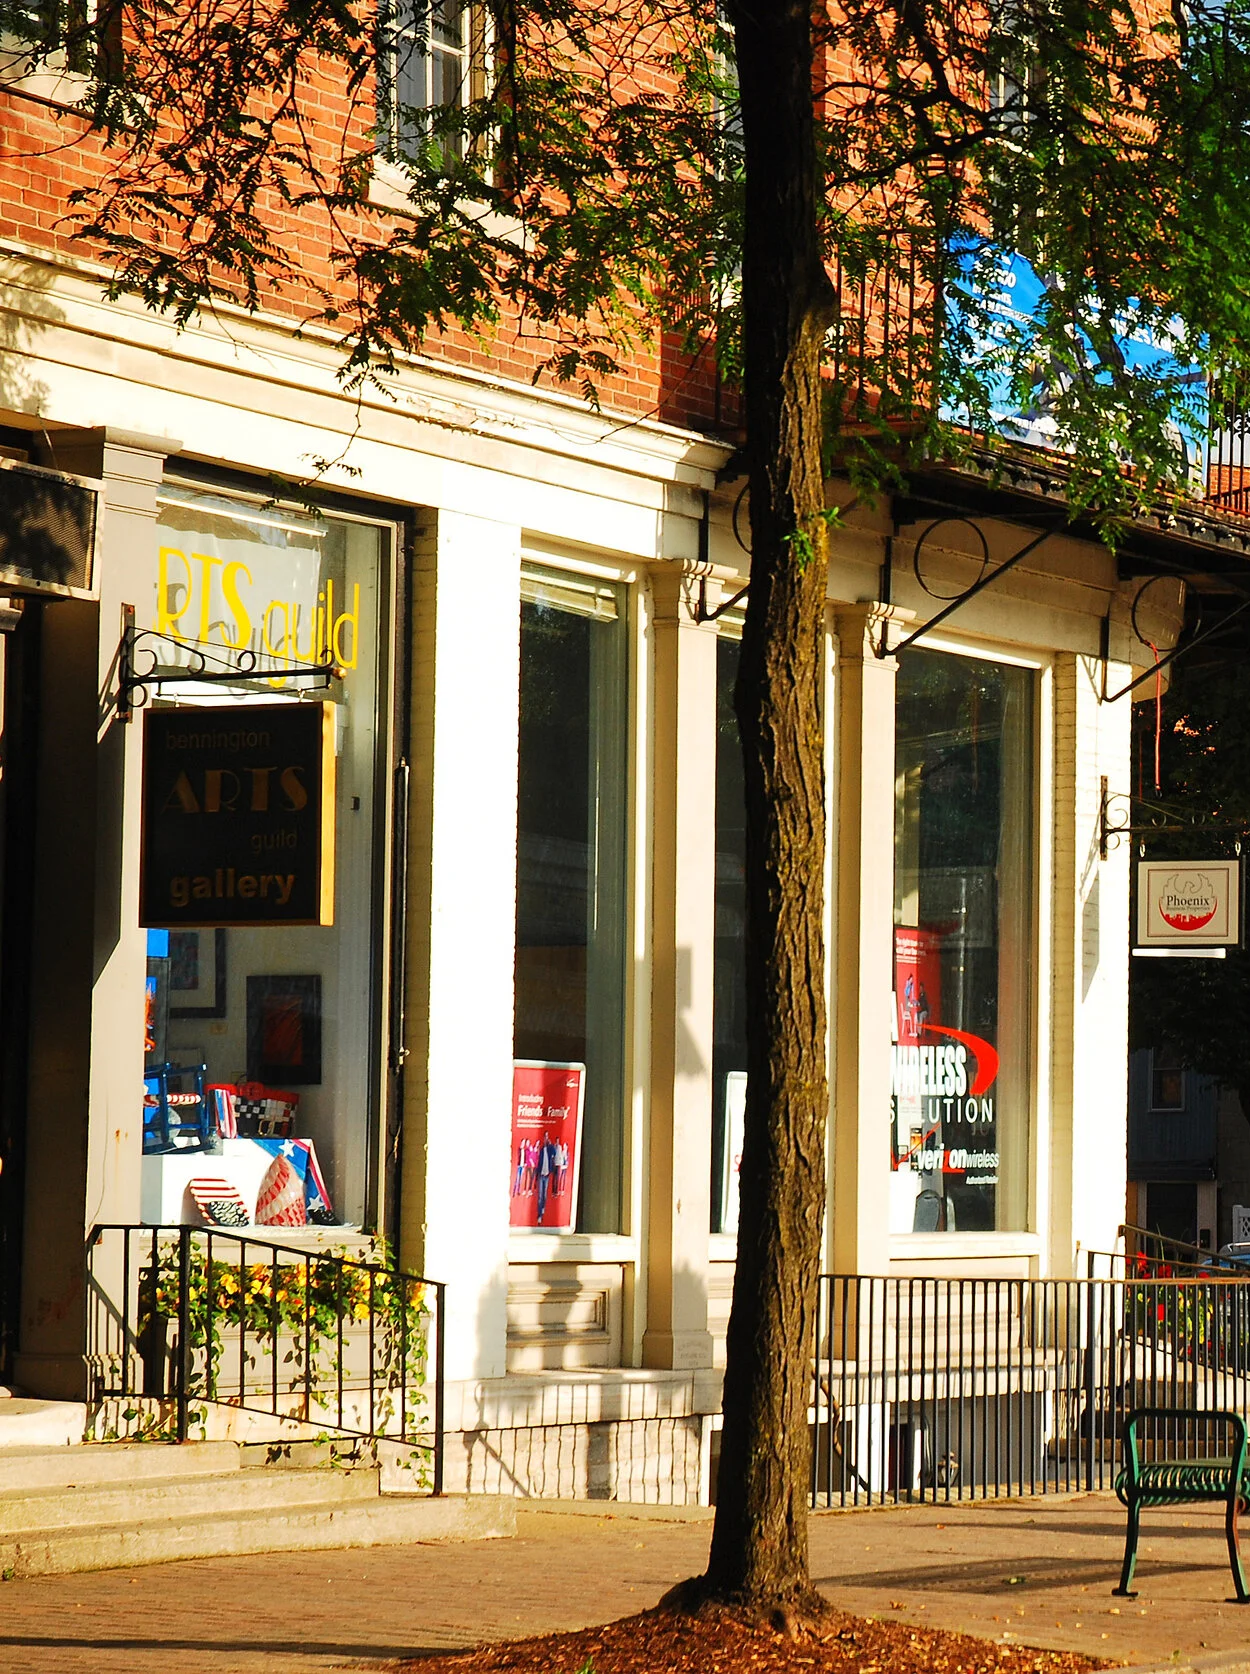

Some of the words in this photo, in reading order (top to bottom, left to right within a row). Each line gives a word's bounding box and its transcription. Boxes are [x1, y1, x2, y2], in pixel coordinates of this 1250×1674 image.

[154, 546, 253, 650] RTS
[262, 578, 360, 688] guild
[165, 729, 270, 753] bennington
[160, 765, 309, 815] ARTS
[250, 826, 299, 857] guild
[169, 867, 297, 908] gallery
[1166, 895, 1210, 906] Phoenix
[517, 1105, 543, 1117] Friends
[889, 1098, 993, 1124] SUTION
